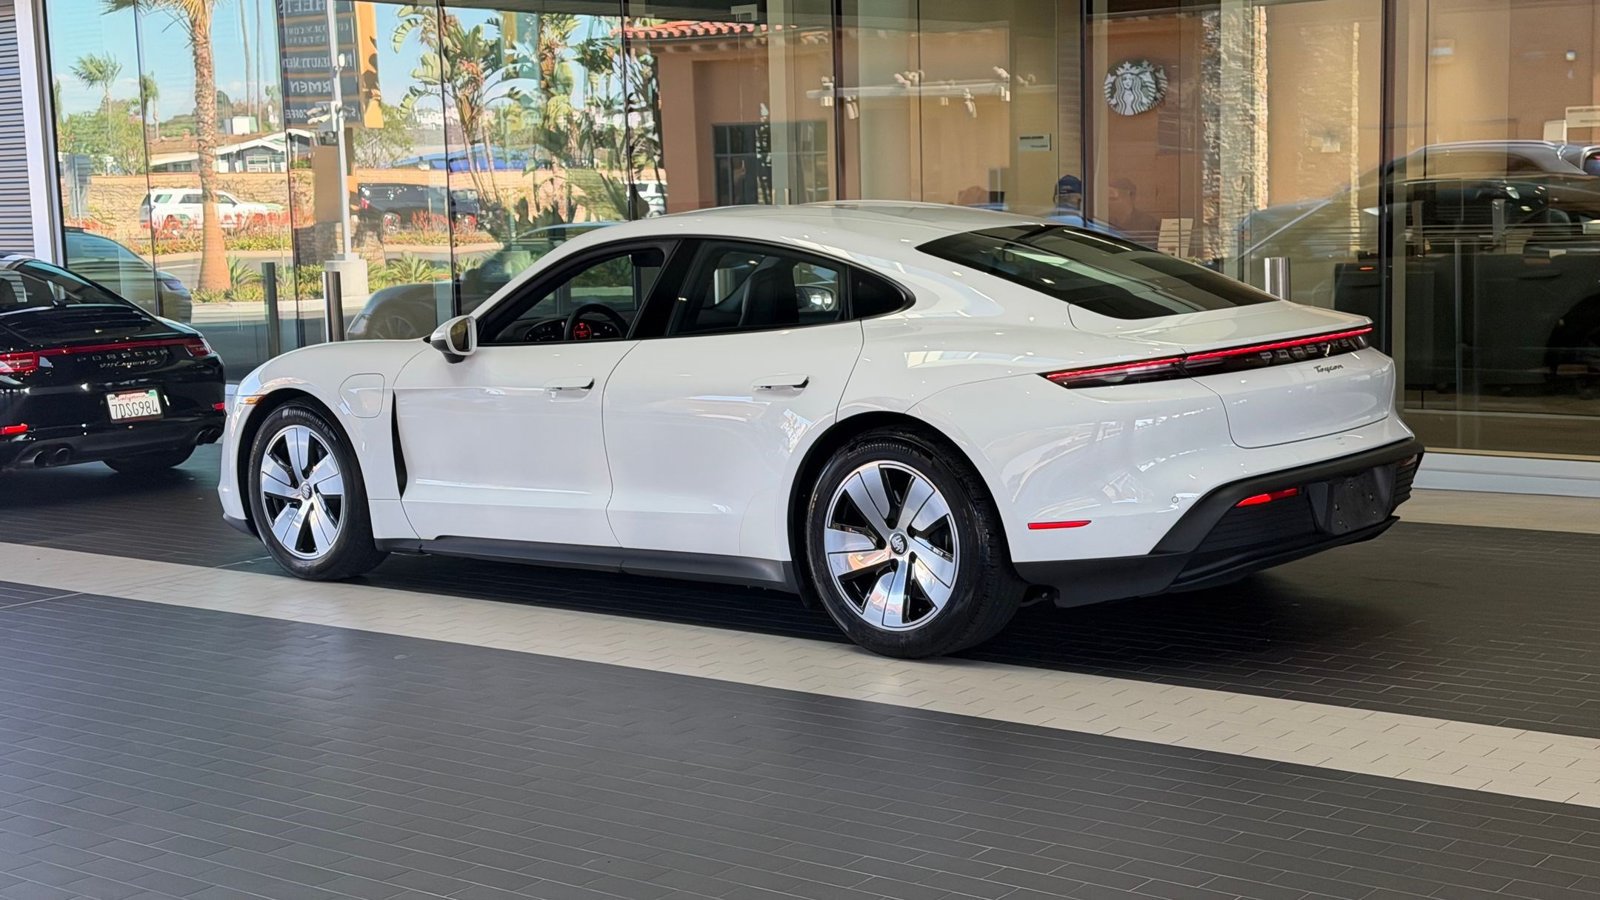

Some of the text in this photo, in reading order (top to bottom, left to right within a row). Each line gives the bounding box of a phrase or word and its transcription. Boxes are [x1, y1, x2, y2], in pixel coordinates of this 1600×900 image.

[77, 349, 169, 362] PORSCHE
[1260, 339, 1350, 361] PORSCHE
[1313, 364, 1344, 374] Taycan
[111, 399, 158, 418] 7DSG984
